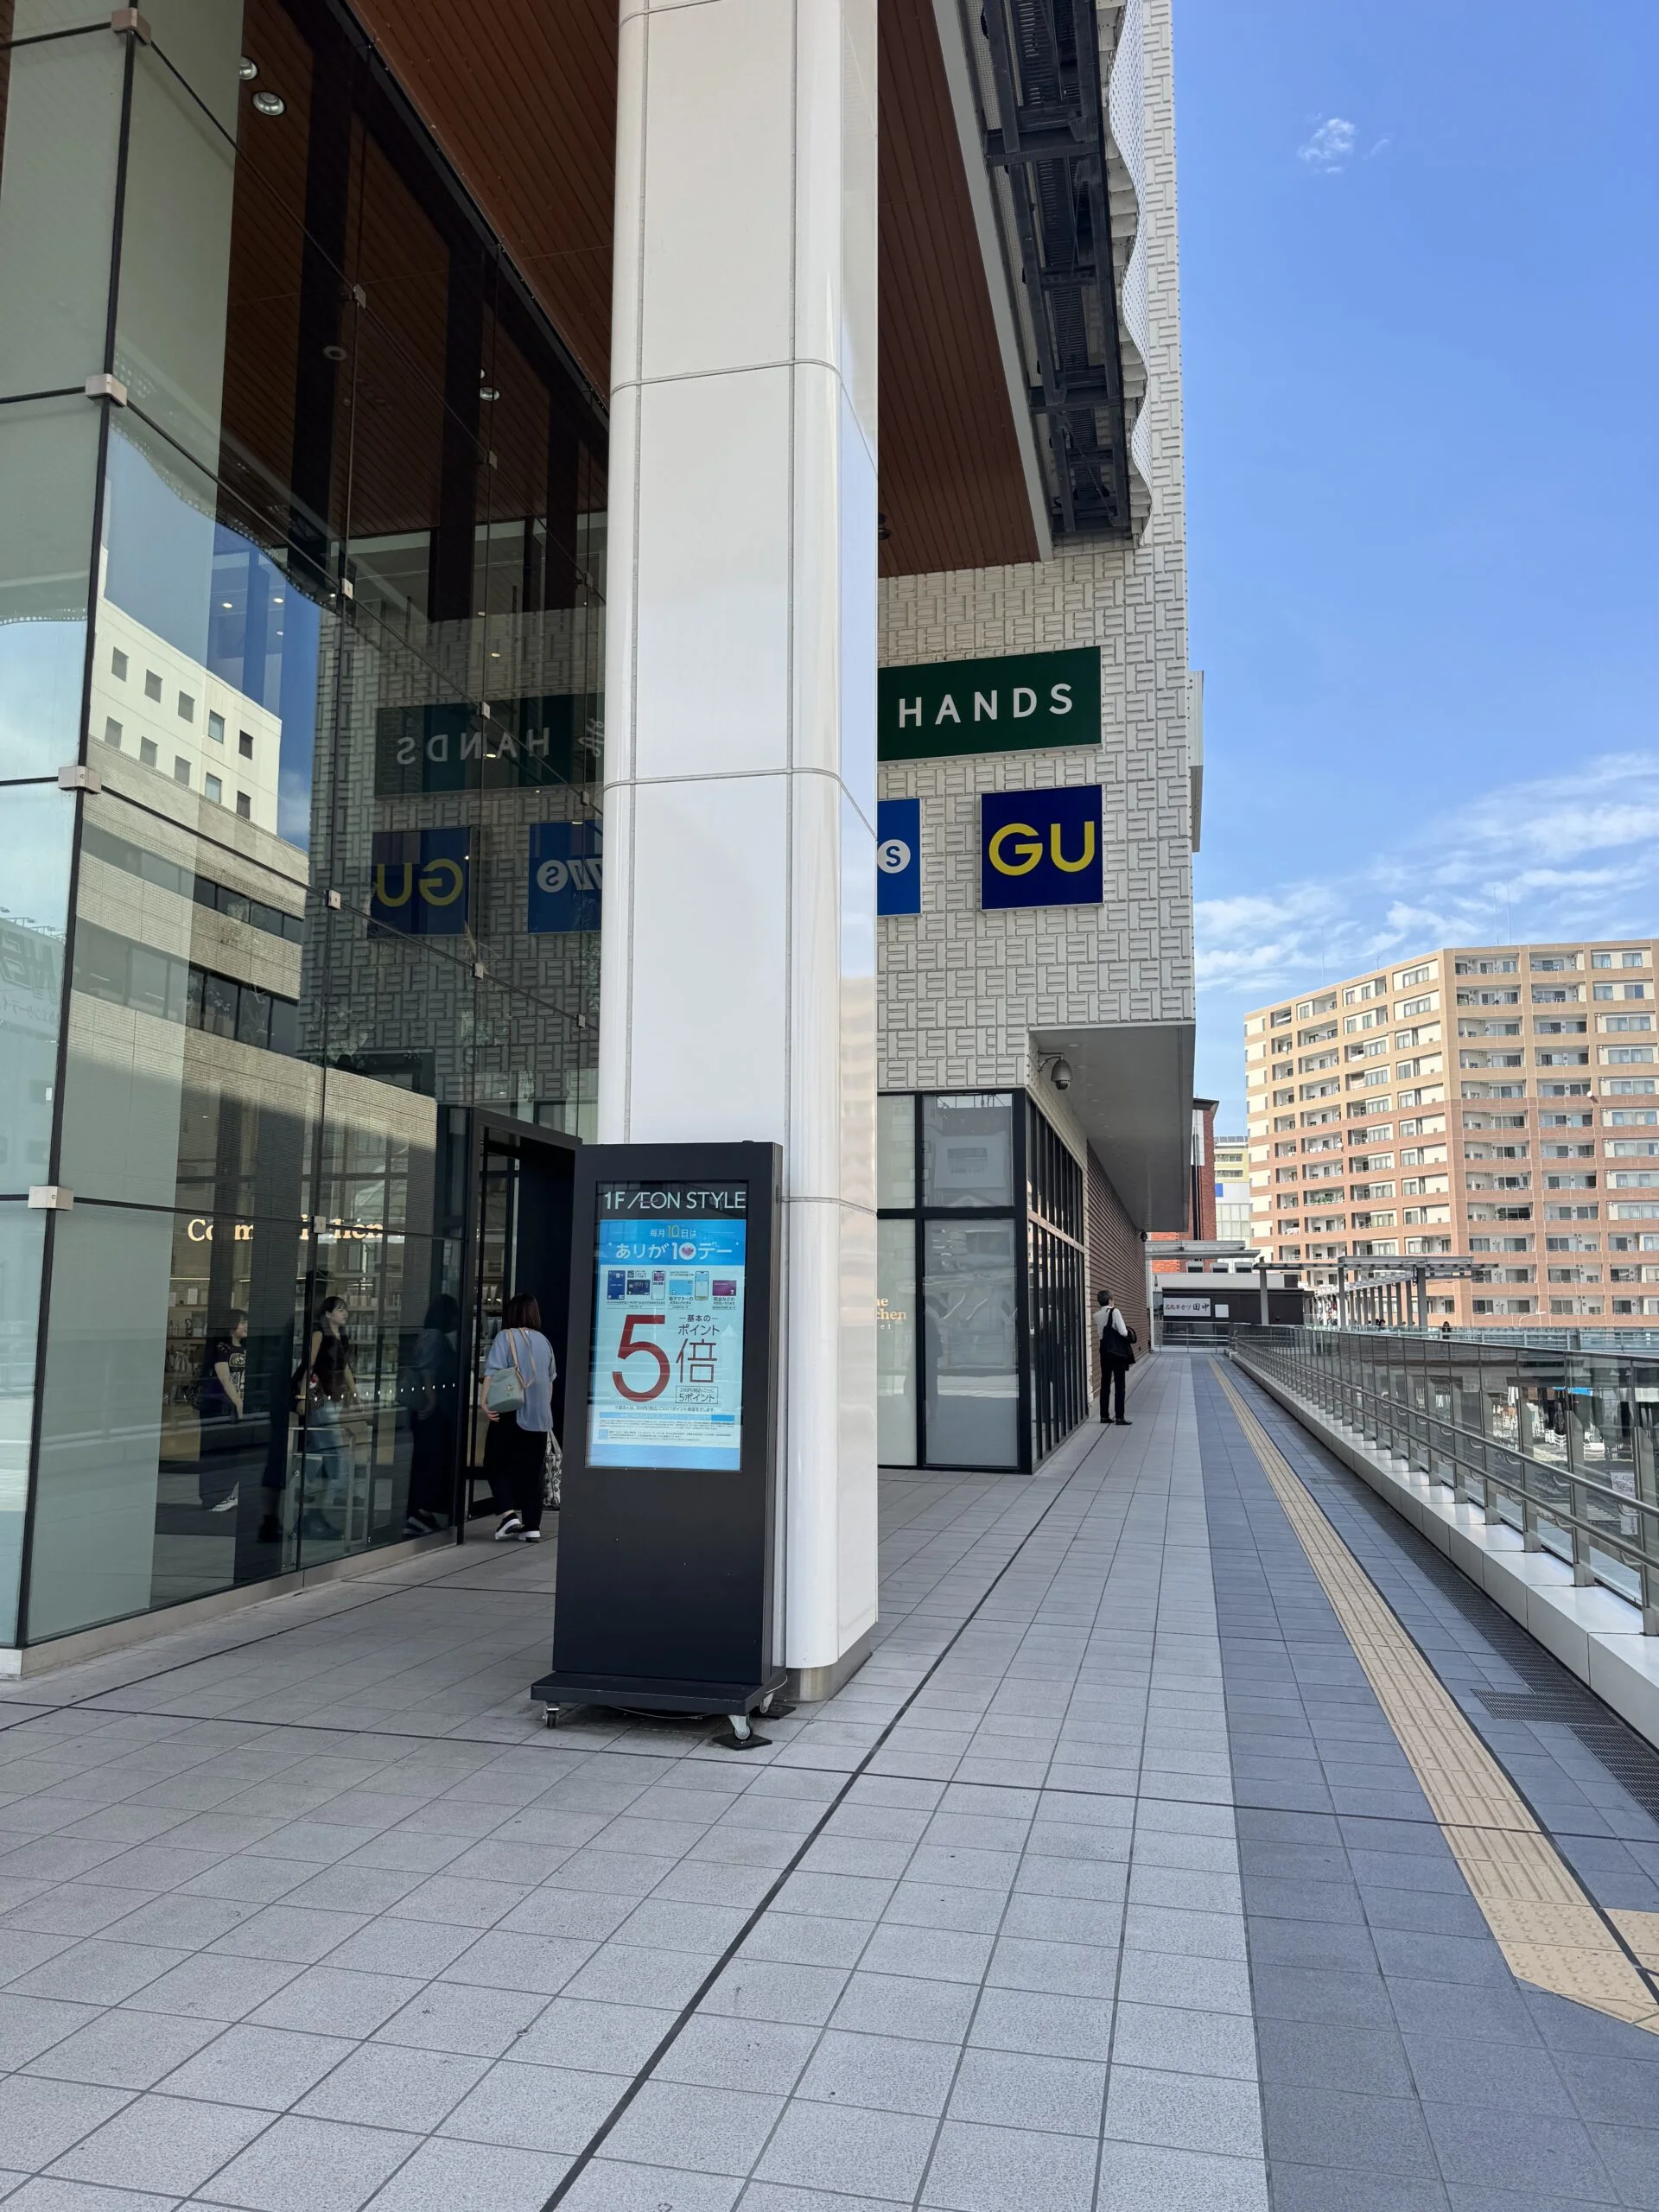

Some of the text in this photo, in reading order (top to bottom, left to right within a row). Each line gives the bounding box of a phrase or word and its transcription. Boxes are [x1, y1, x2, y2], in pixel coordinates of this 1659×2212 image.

[899, 683, 1073, 728] HANDS
[988, 821, 1095, 876] GU
[604, 1191, 626, 1210] 1F
[686, 1192, 747, 1209] STYLE
[650, 1225, 696, 1238] 毎月10日は
[687, 1314, 711, 1323] 基本の
[678, 1324, 720, 1336] ポイント
[612, 1314, 671, 1402] 5
[676, 1338, 717, 1383] 倍
[678, 1393, 715, 1403] 5ポイント
